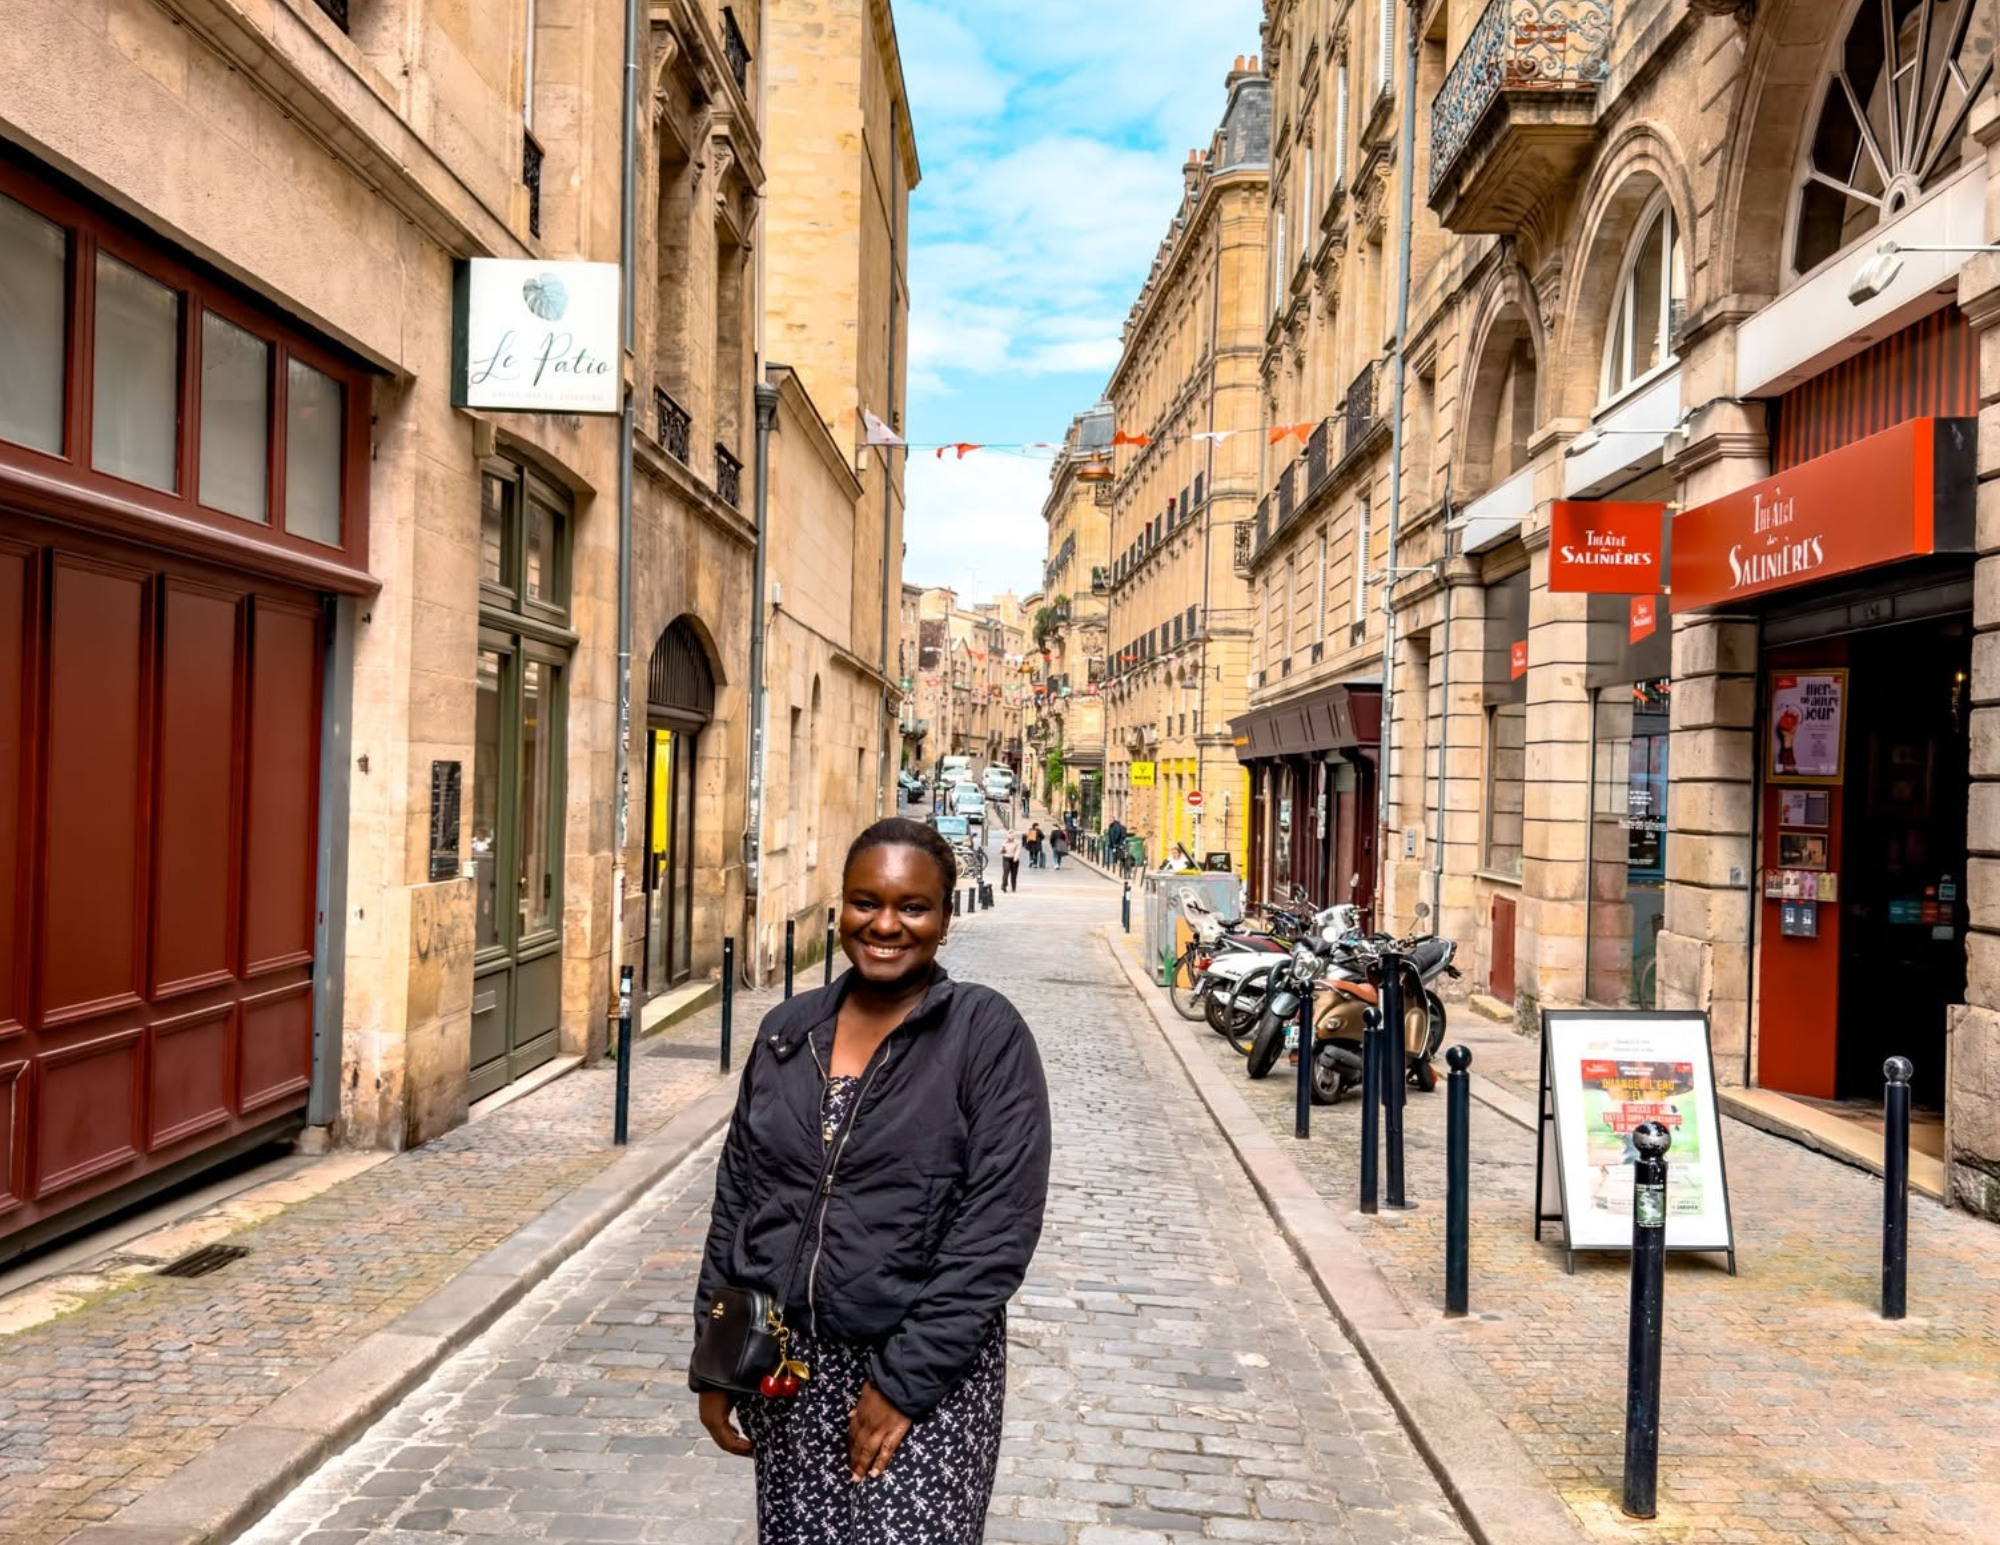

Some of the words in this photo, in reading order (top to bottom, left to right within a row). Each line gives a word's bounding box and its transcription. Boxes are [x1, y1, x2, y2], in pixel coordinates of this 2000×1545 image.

[471, 330, 520, 384] Le
[533, 332, 613, 386] Patio
[1561, 546, 1652, 566] SALINIÈRES
[1728, 534, 1824, 590] SALINIÈRES
